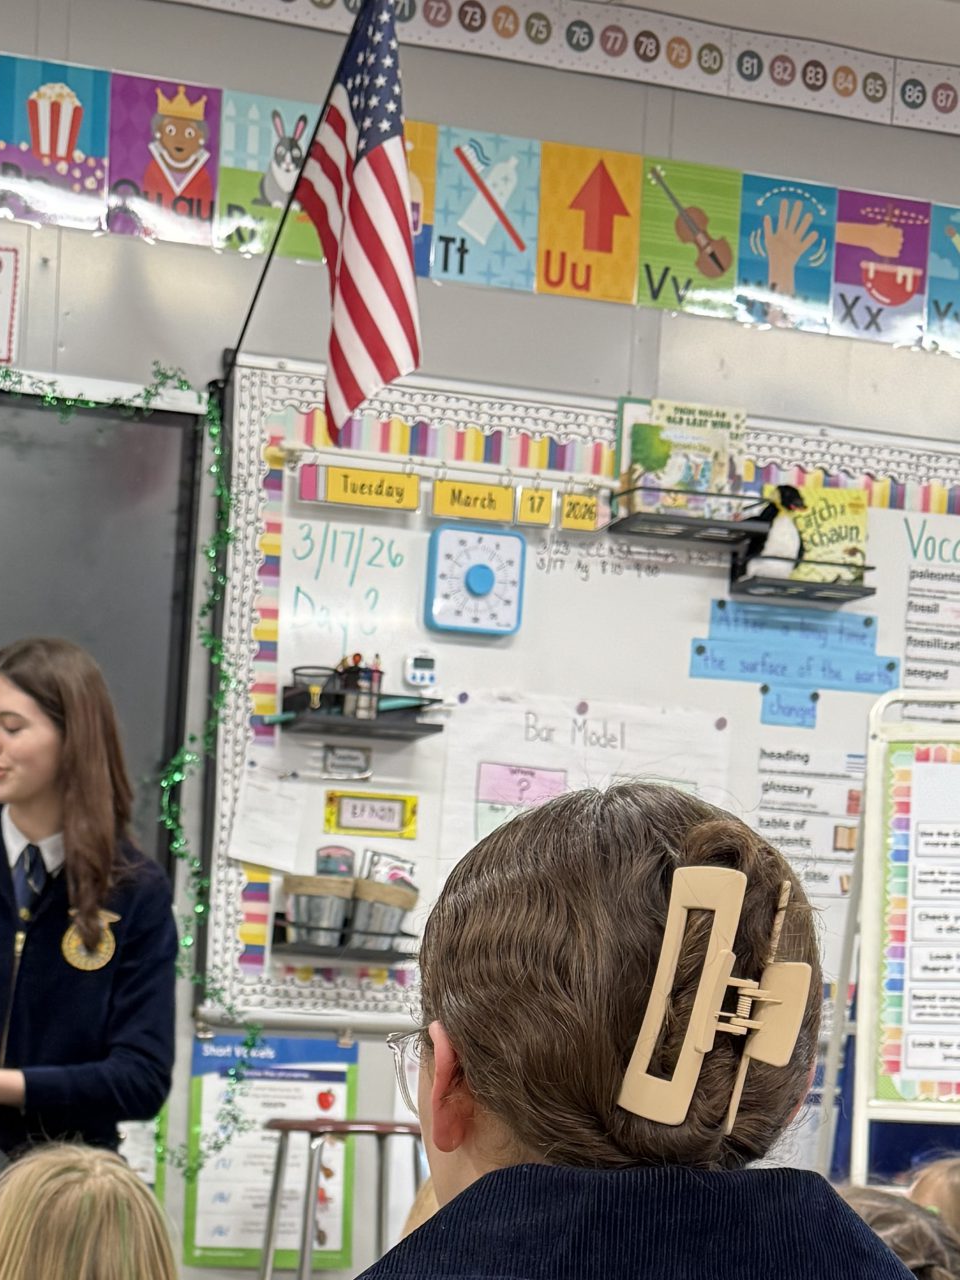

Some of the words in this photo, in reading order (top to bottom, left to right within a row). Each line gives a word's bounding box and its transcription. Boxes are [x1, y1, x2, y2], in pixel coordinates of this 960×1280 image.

[429, 2, 447, 22] 72
[464, 6, 481, 27] 73
[497, 12, 513, 31] 74
[530, 19, 547, 37] 75
[572, 27, 589, 47] 76
[606, 33, 622, 50] 77
[639, 37, 656, 57] 78
[671, 44, 687, 61] 79
[701, 51, 720, 69] 80
[742, 56, 758, 75] 81
[774, 61, 791, 80] 82
[806, 67, 823, 86] 83
[836, 73, 853, 91] 84
[866, 79, 883, 98] 85
[905, 84, 922, 102] 86
[937, 89, 953, 107] 87
[438, 235, 468, 275] Tt
[543, 249, 592, 292] Uu
[644, 263, 693, 305] Vv
[840, 293, 884, 333] Xx
[340, 473, 405, 503] Tuesday
[449, 488, 497, 511] March
[527, 496, 545, 514] 17
[565, 500, 597, 522] 2026
[292, 521, 404, 587] 3/17/26
[525, 711, 556, 743] Bar
[571, 717, 626, 750] Model
[760, 748, 810, 765] heading
